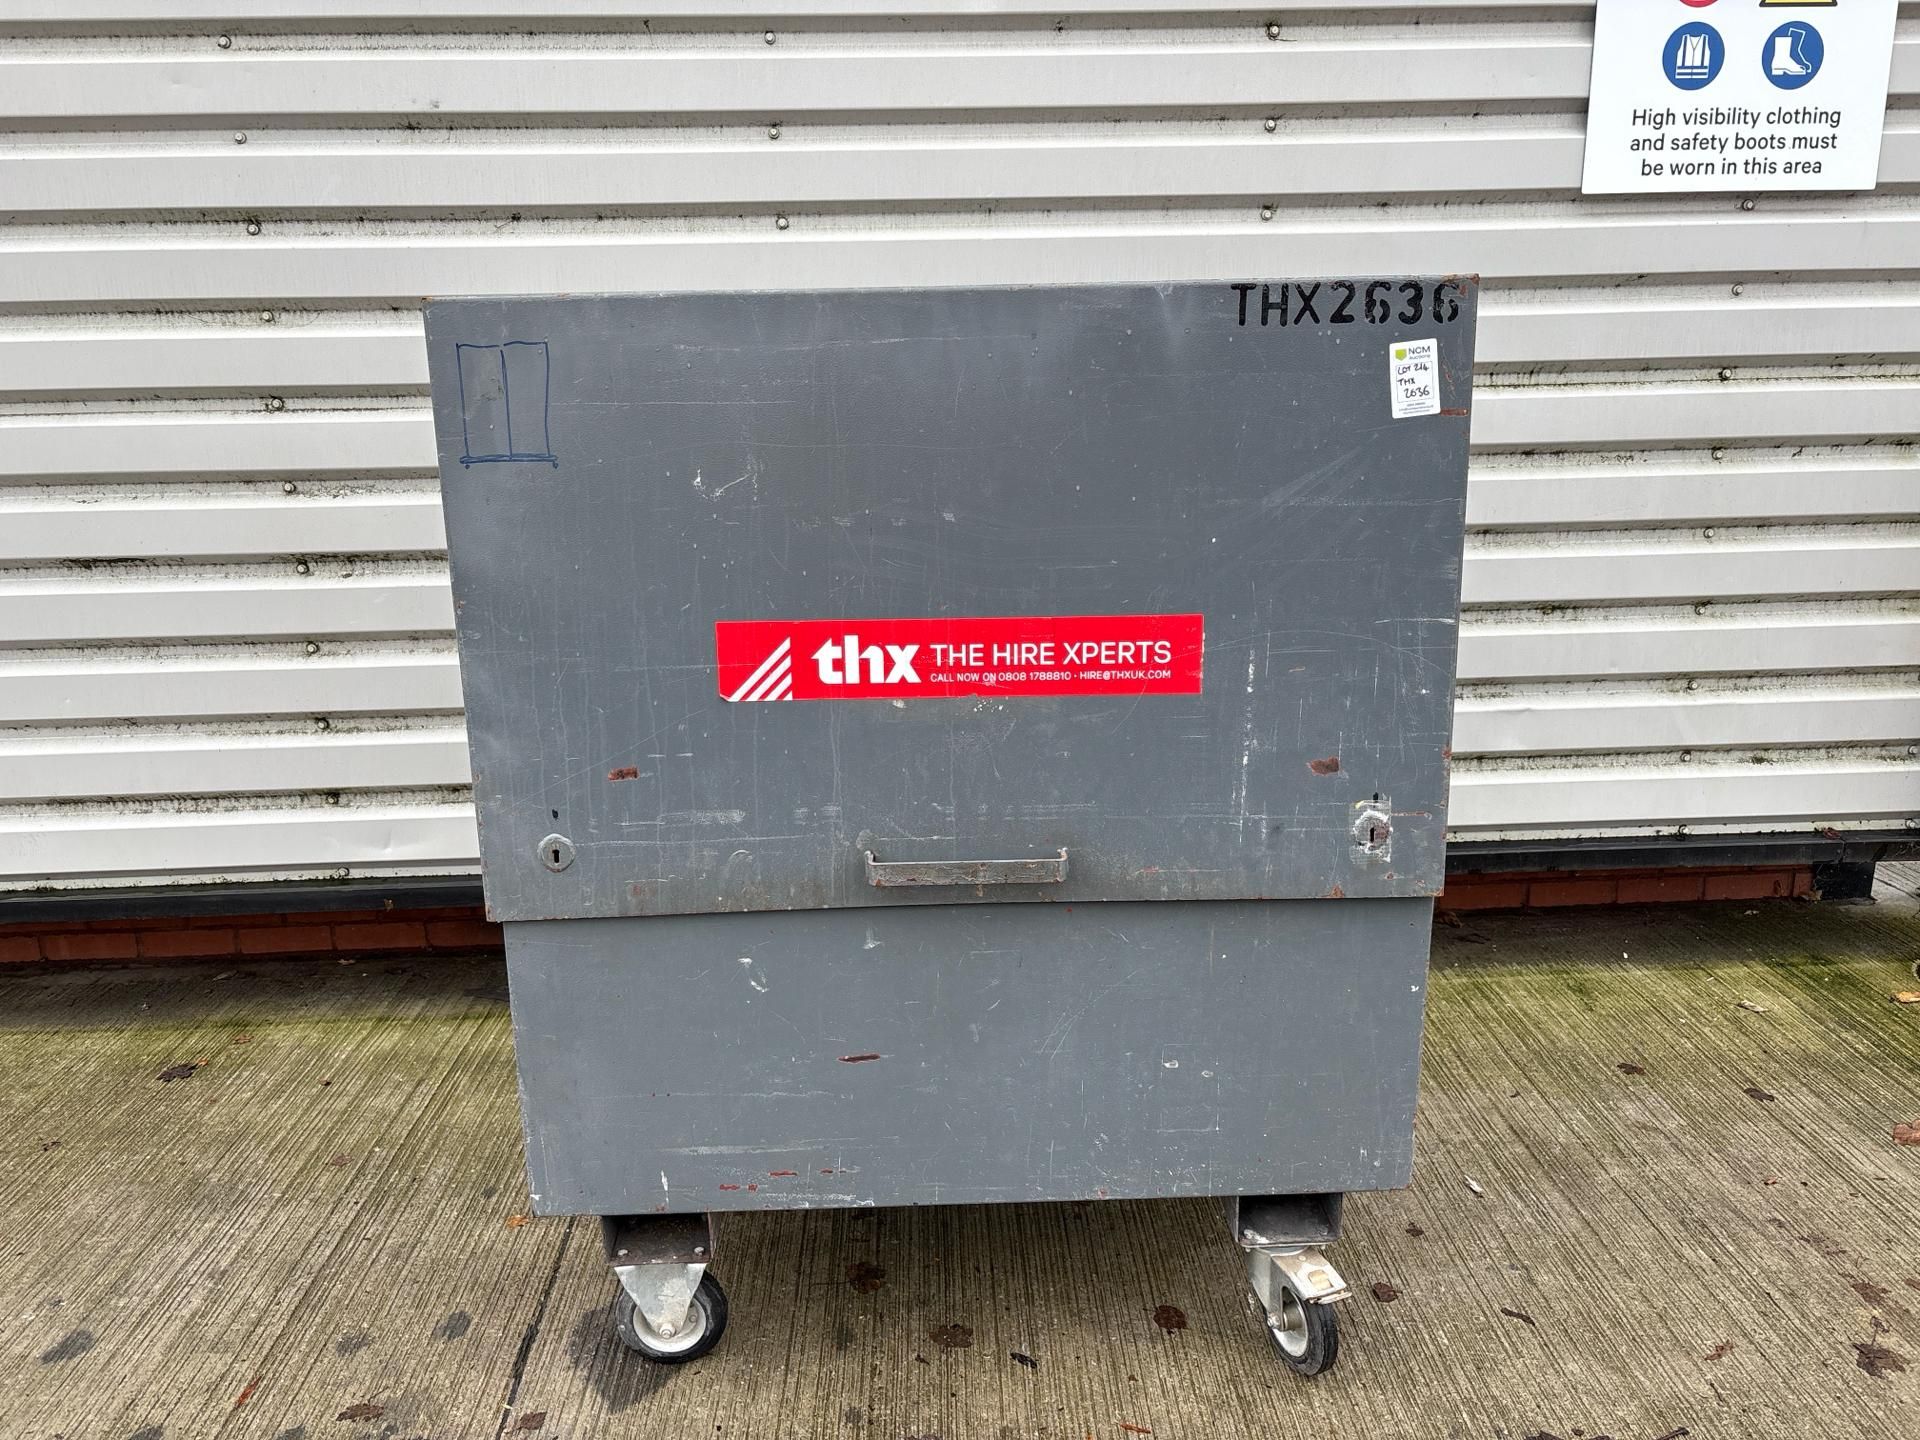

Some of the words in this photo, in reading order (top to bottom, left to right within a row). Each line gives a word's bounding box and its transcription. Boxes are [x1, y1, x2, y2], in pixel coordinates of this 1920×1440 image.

[1632, 109, 1676, 129] High
[1683, 107, 1761, 129] visibility
[1766, 106, 1842, 128] clothing
[1630, 133, 1665, 151] and
[1671, 132, 1729, 153] safety
[1734, 132, 1786, 150] boots
[1791, 132, 1838, 149] must
[1641, 159, 1664, 176] be
[1670, 160, 1715, 175] worn
[1722, 158, 1737, 174] in
[1743, 157, 1777, 174] this
[1783, 158, 1822, 174] area
[1230, 280, 1460, 327] THX2636
[1408, 346, 1431, 354] NCM
[1397, 366, 1411, 375] LOT
[1397, 377, 1415, 386] THX
[1404, 384, 1430, 398] 2636
[811, 635, 922, 685] thx
[930, 643, 985, 667] THE
[992, 642, 1056, 666] HIRE
[1062, 640, 1172, 665] XPERTS
[930, 672, 954, 683] CALL
[956, 672, 980, 683] NOW
[982, 671, 997, 683] ON
[998, 671, 1027, 682] 0808
[1079, 669, 1171, 680] HIRE@THXUK.COM
